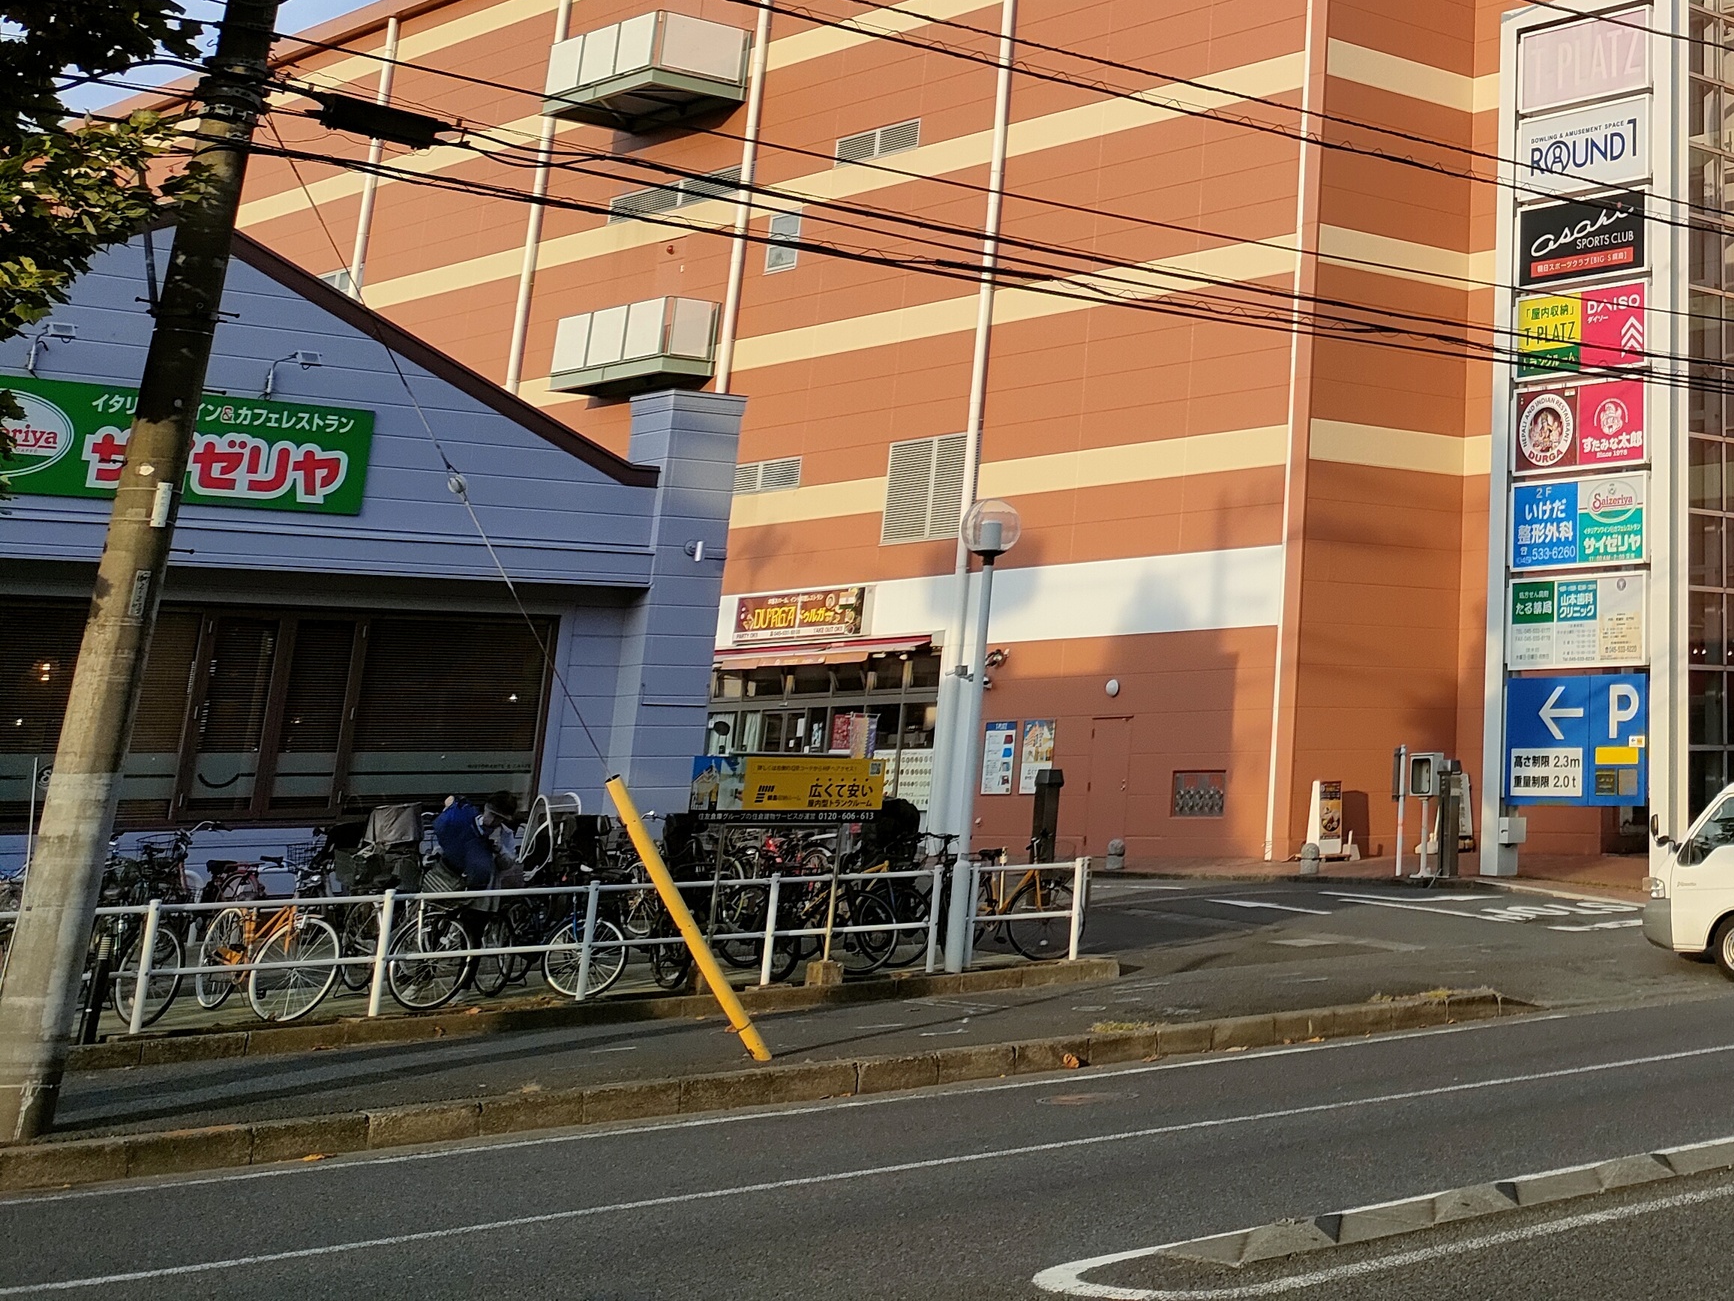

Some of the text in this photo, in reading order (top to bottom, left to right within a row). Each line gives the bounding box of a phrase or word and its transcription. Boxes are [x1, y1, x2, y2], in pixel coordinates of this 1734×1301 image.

[1531, 133, 1558, 145] BOWLING
[1564, 124, 1603, 138] AMUSEMENT
[1604, 120, 1625, 130] SPACE
[1576, 231, 1634, 250] SPORTS CLUB
[1587, 293, 1641, 315] DAISO
[1587, 314, 1609, 324] ダイソー
[1524, 321, 1576, 346] TPLATZ
[1525, 404, 1536, 420] AND
[1535, 397, 1556, 407] INDIAN
[1555, 399, 1571, 444] RESTAURANT
[1582, 430, 1643, 453] すたみな太郎
[1528, 448, 1564, 464] DURGA
[1525, 497, 1567, 521] いけだ
[1592, 492, 1633, 510] Saizeriya
[1517, 520, 1574, 545] 整形外科
[1532, 545, 1576, 561] 533-6260
[1583, 533, 1641, 555] サイゼリヤ
[753, 604, 797, 630] DURGA
[1559, 604, 1595, 619] クリニック
[1608, 683, 1640, 739] P
[1513, 755, 1581, 768] 高さ制限 2.3m
[808, 783, 874, 799] 広くて安い
[1513, 775, 1550, 789] 重量制限
